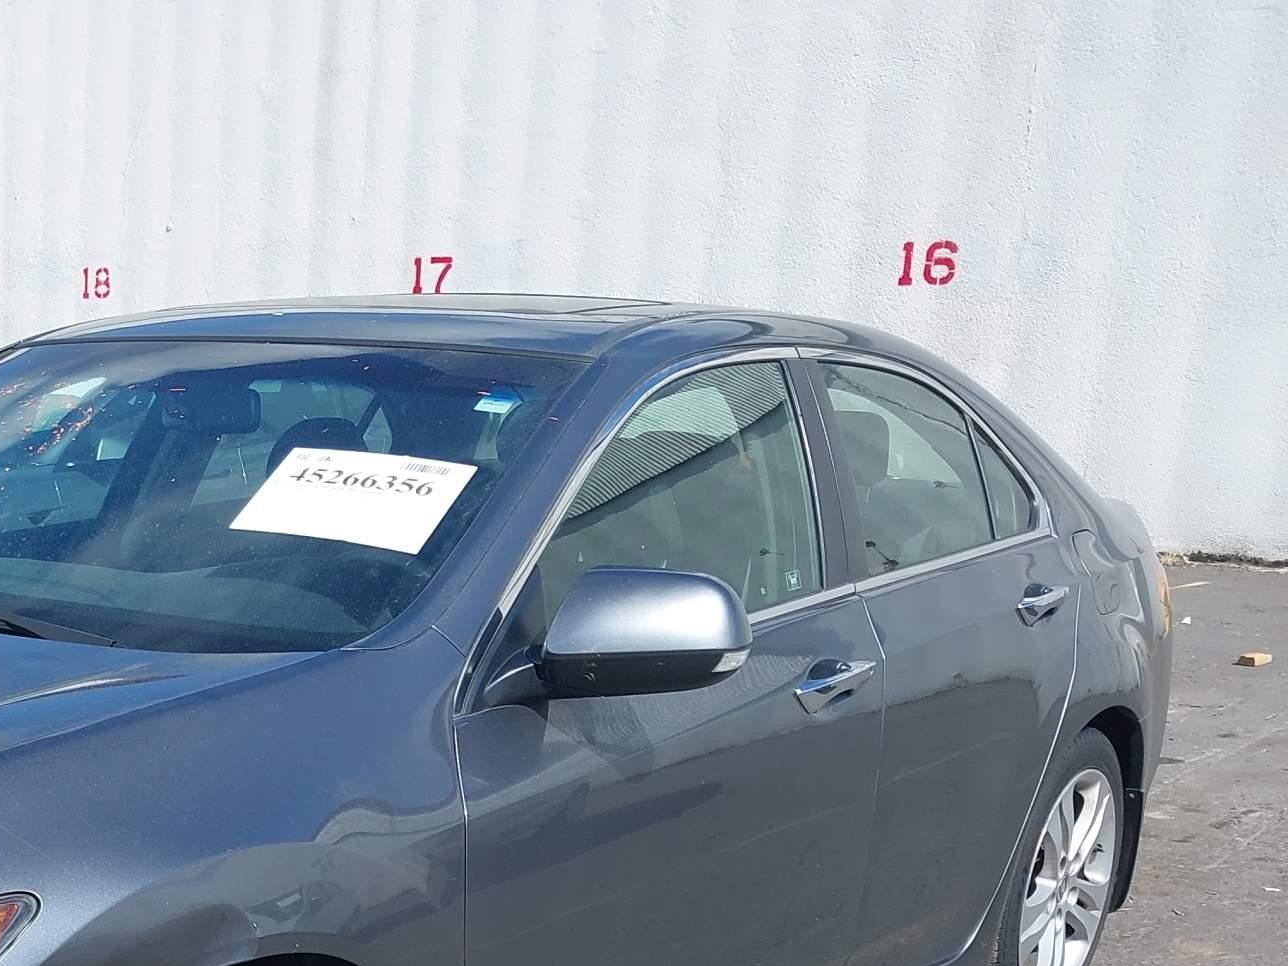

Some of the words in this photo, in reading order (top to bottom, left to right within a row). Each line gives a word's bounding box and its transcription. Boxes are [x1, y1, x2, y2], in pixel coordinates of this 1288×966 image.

[412, 256, 453, 295] 17
[898, 240, 960, 287] 16
[82, 266, 111, 300] 18
[289, 467, 434, 497] 45266356
